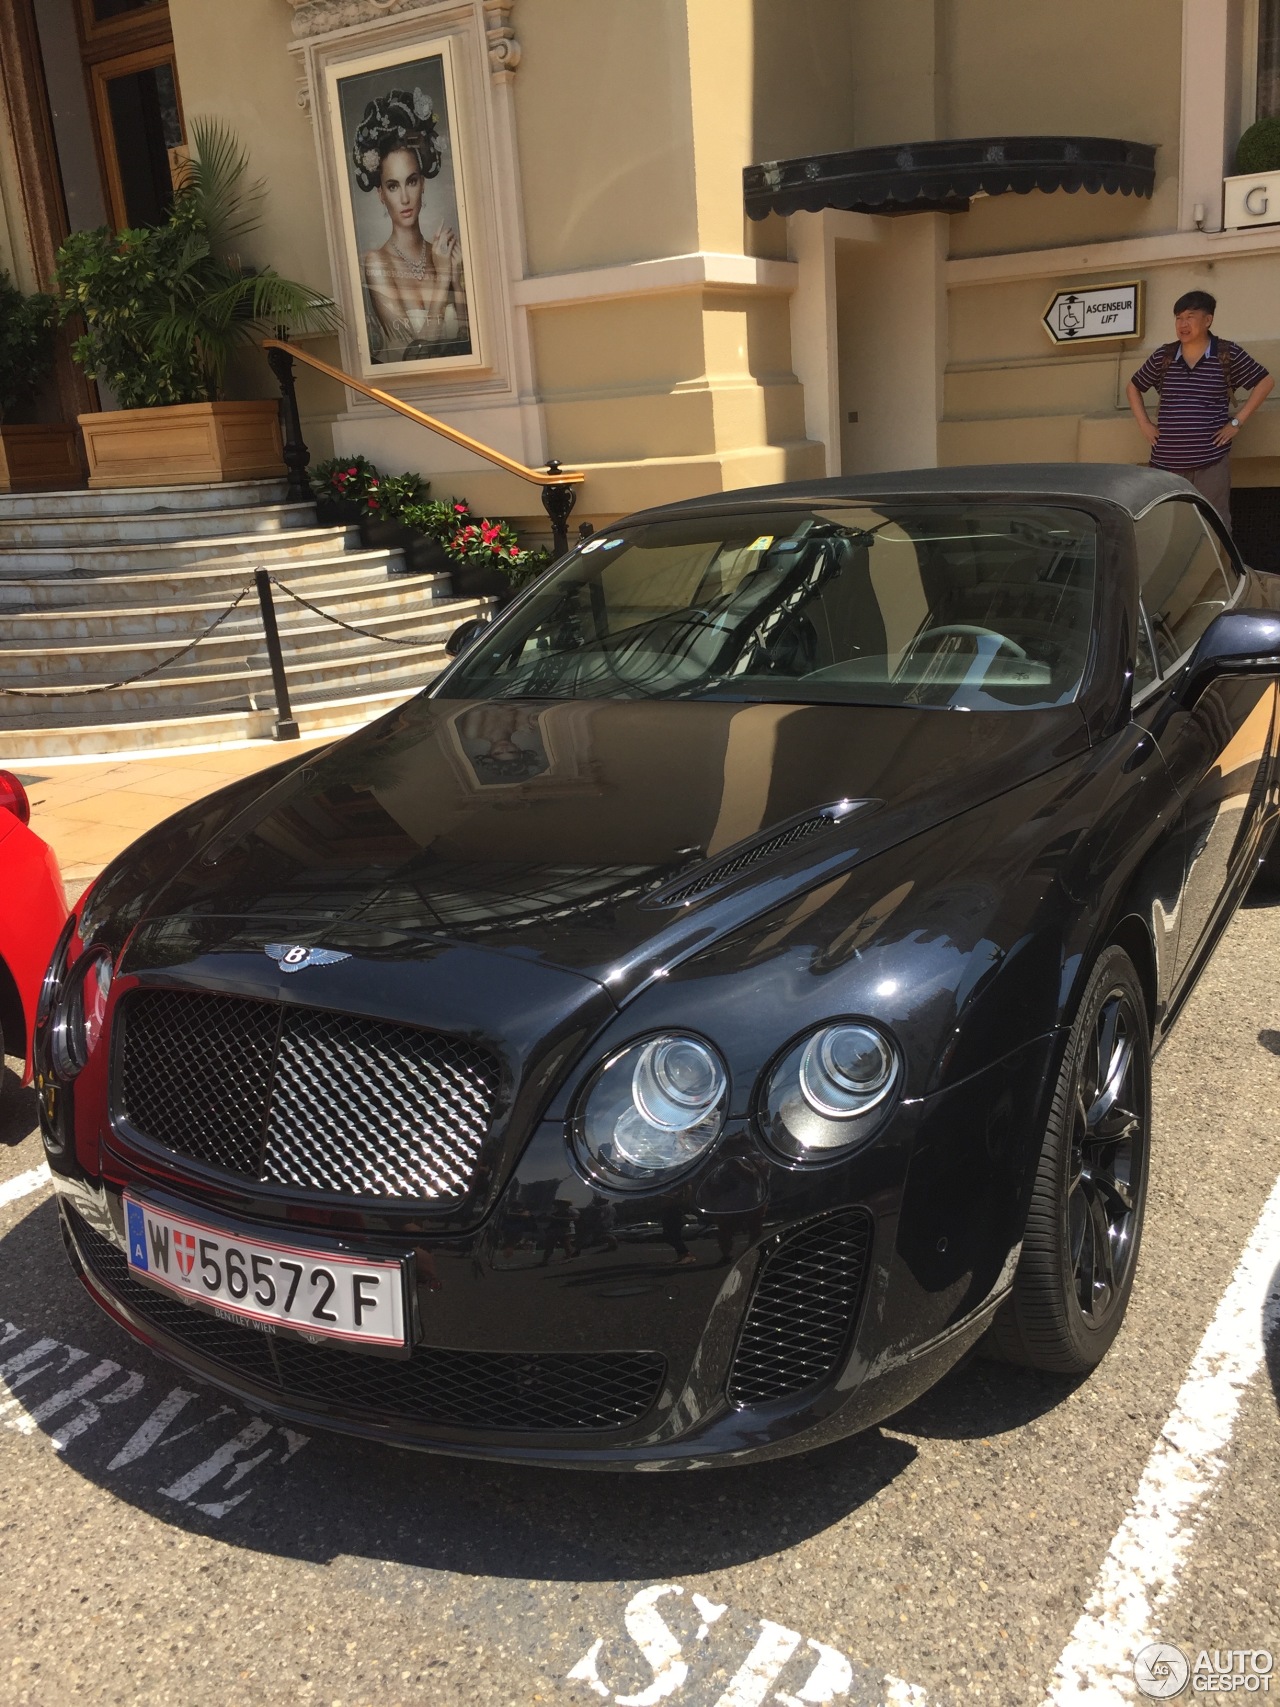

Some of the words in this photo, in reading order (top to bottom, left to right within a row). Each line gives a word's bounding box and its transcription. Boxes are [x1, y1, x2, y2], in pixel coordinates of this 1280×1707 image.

[1245, 186, 1269, 216] G
[1086, 301, 1132, 314] ASCENSEUR
[1101, 314, 1118, 324] LIFT
[284, 947, 307, 963] B
[135, 1244, 144, 1260] A
[148, 1219, 169, 1274] W
[214, 1308, 250, 1327] BENTLEY
[252, 1319, 277, 1335] WIEN
